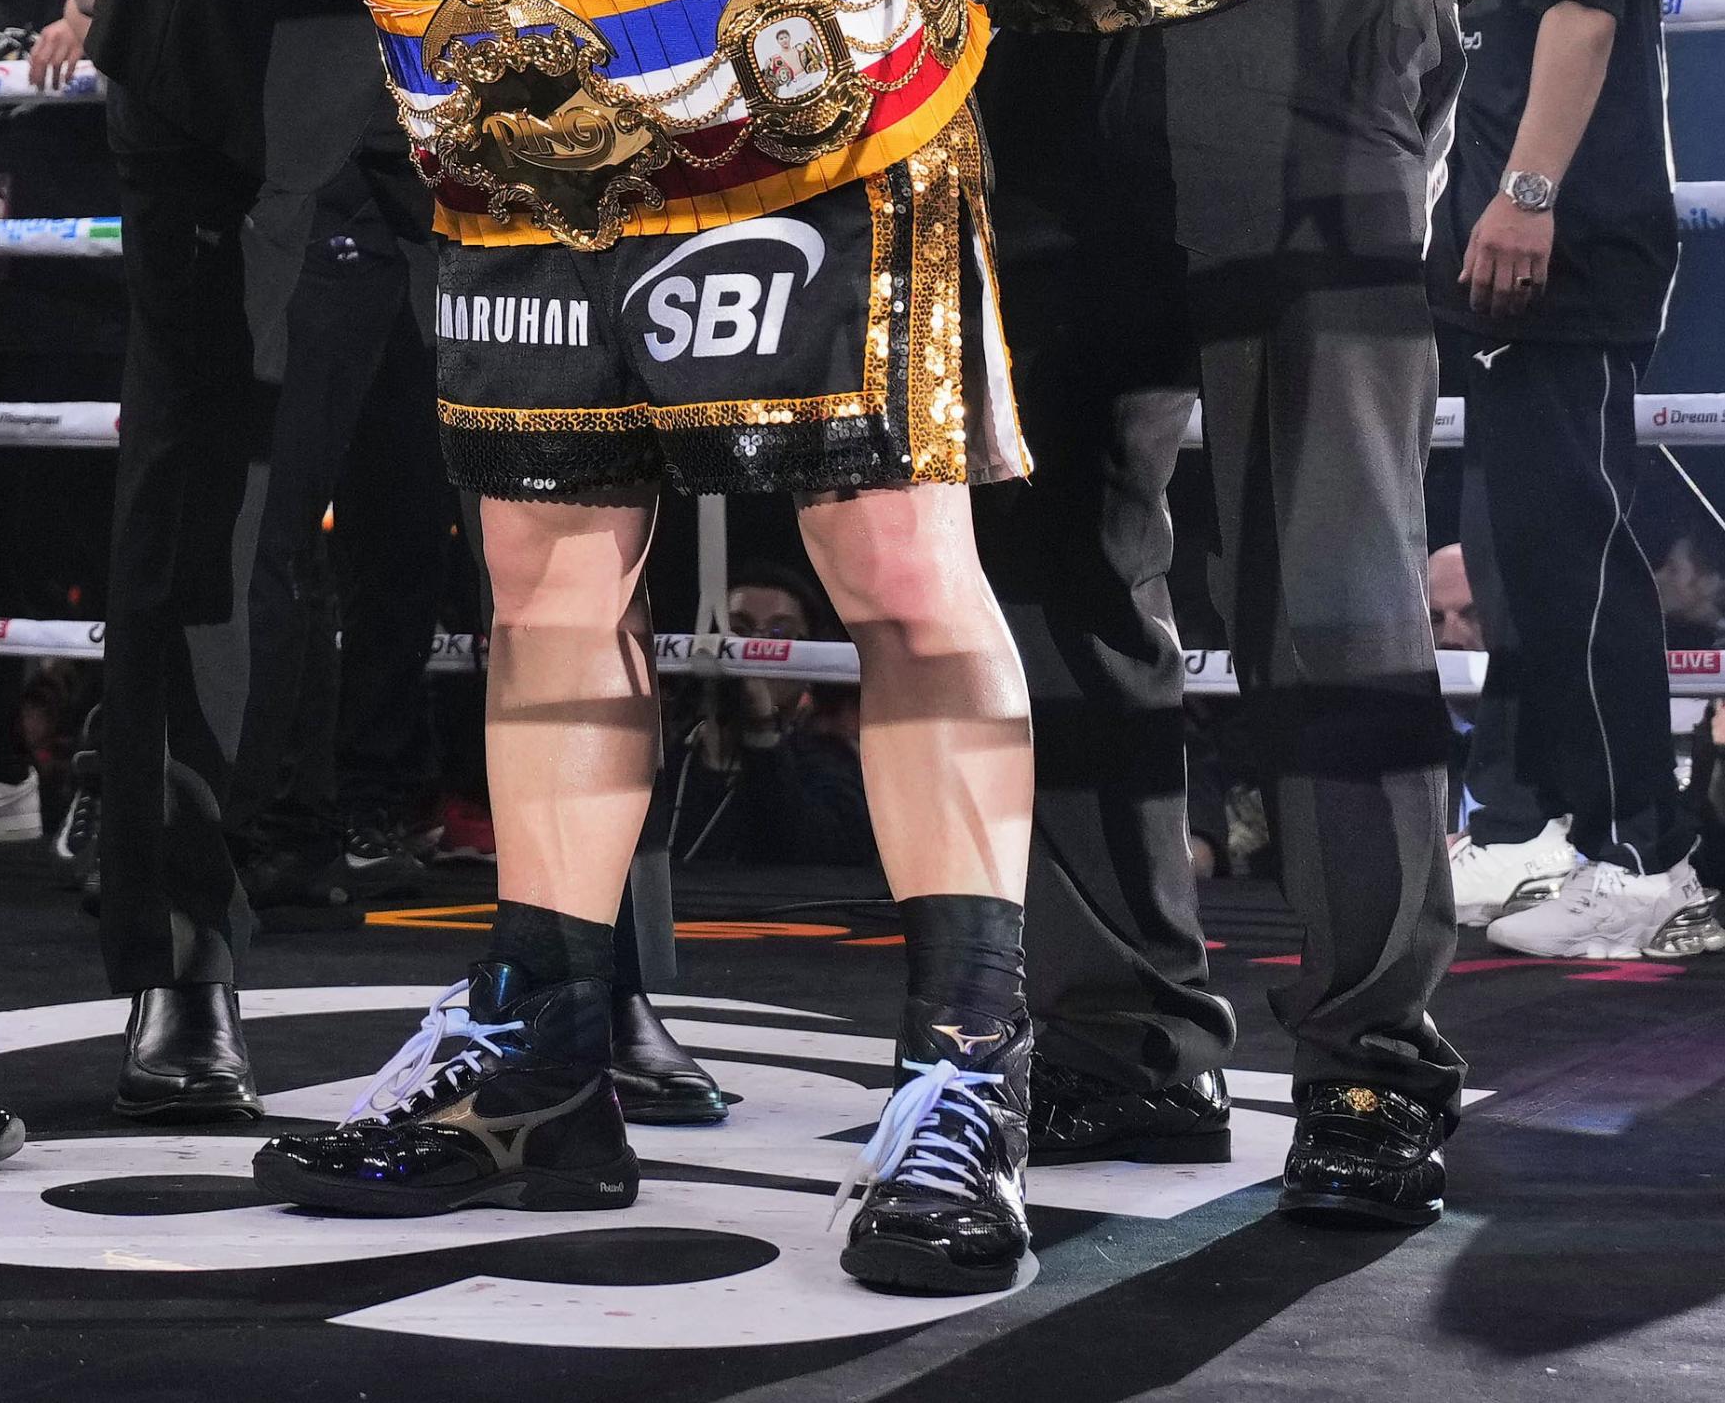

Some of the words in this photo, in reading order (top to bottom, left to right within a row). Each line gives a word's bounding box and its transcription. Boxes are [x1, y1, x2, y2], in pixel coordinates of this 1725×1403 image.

[435, 287, 589, 347] MARUHAN
[643, 271, 796, 363] SBI
[1670, 409, 1719, 424] Dream
[745, 639, 788, 658] LIVE
[1668, 651, 1716, 670] LIVE
